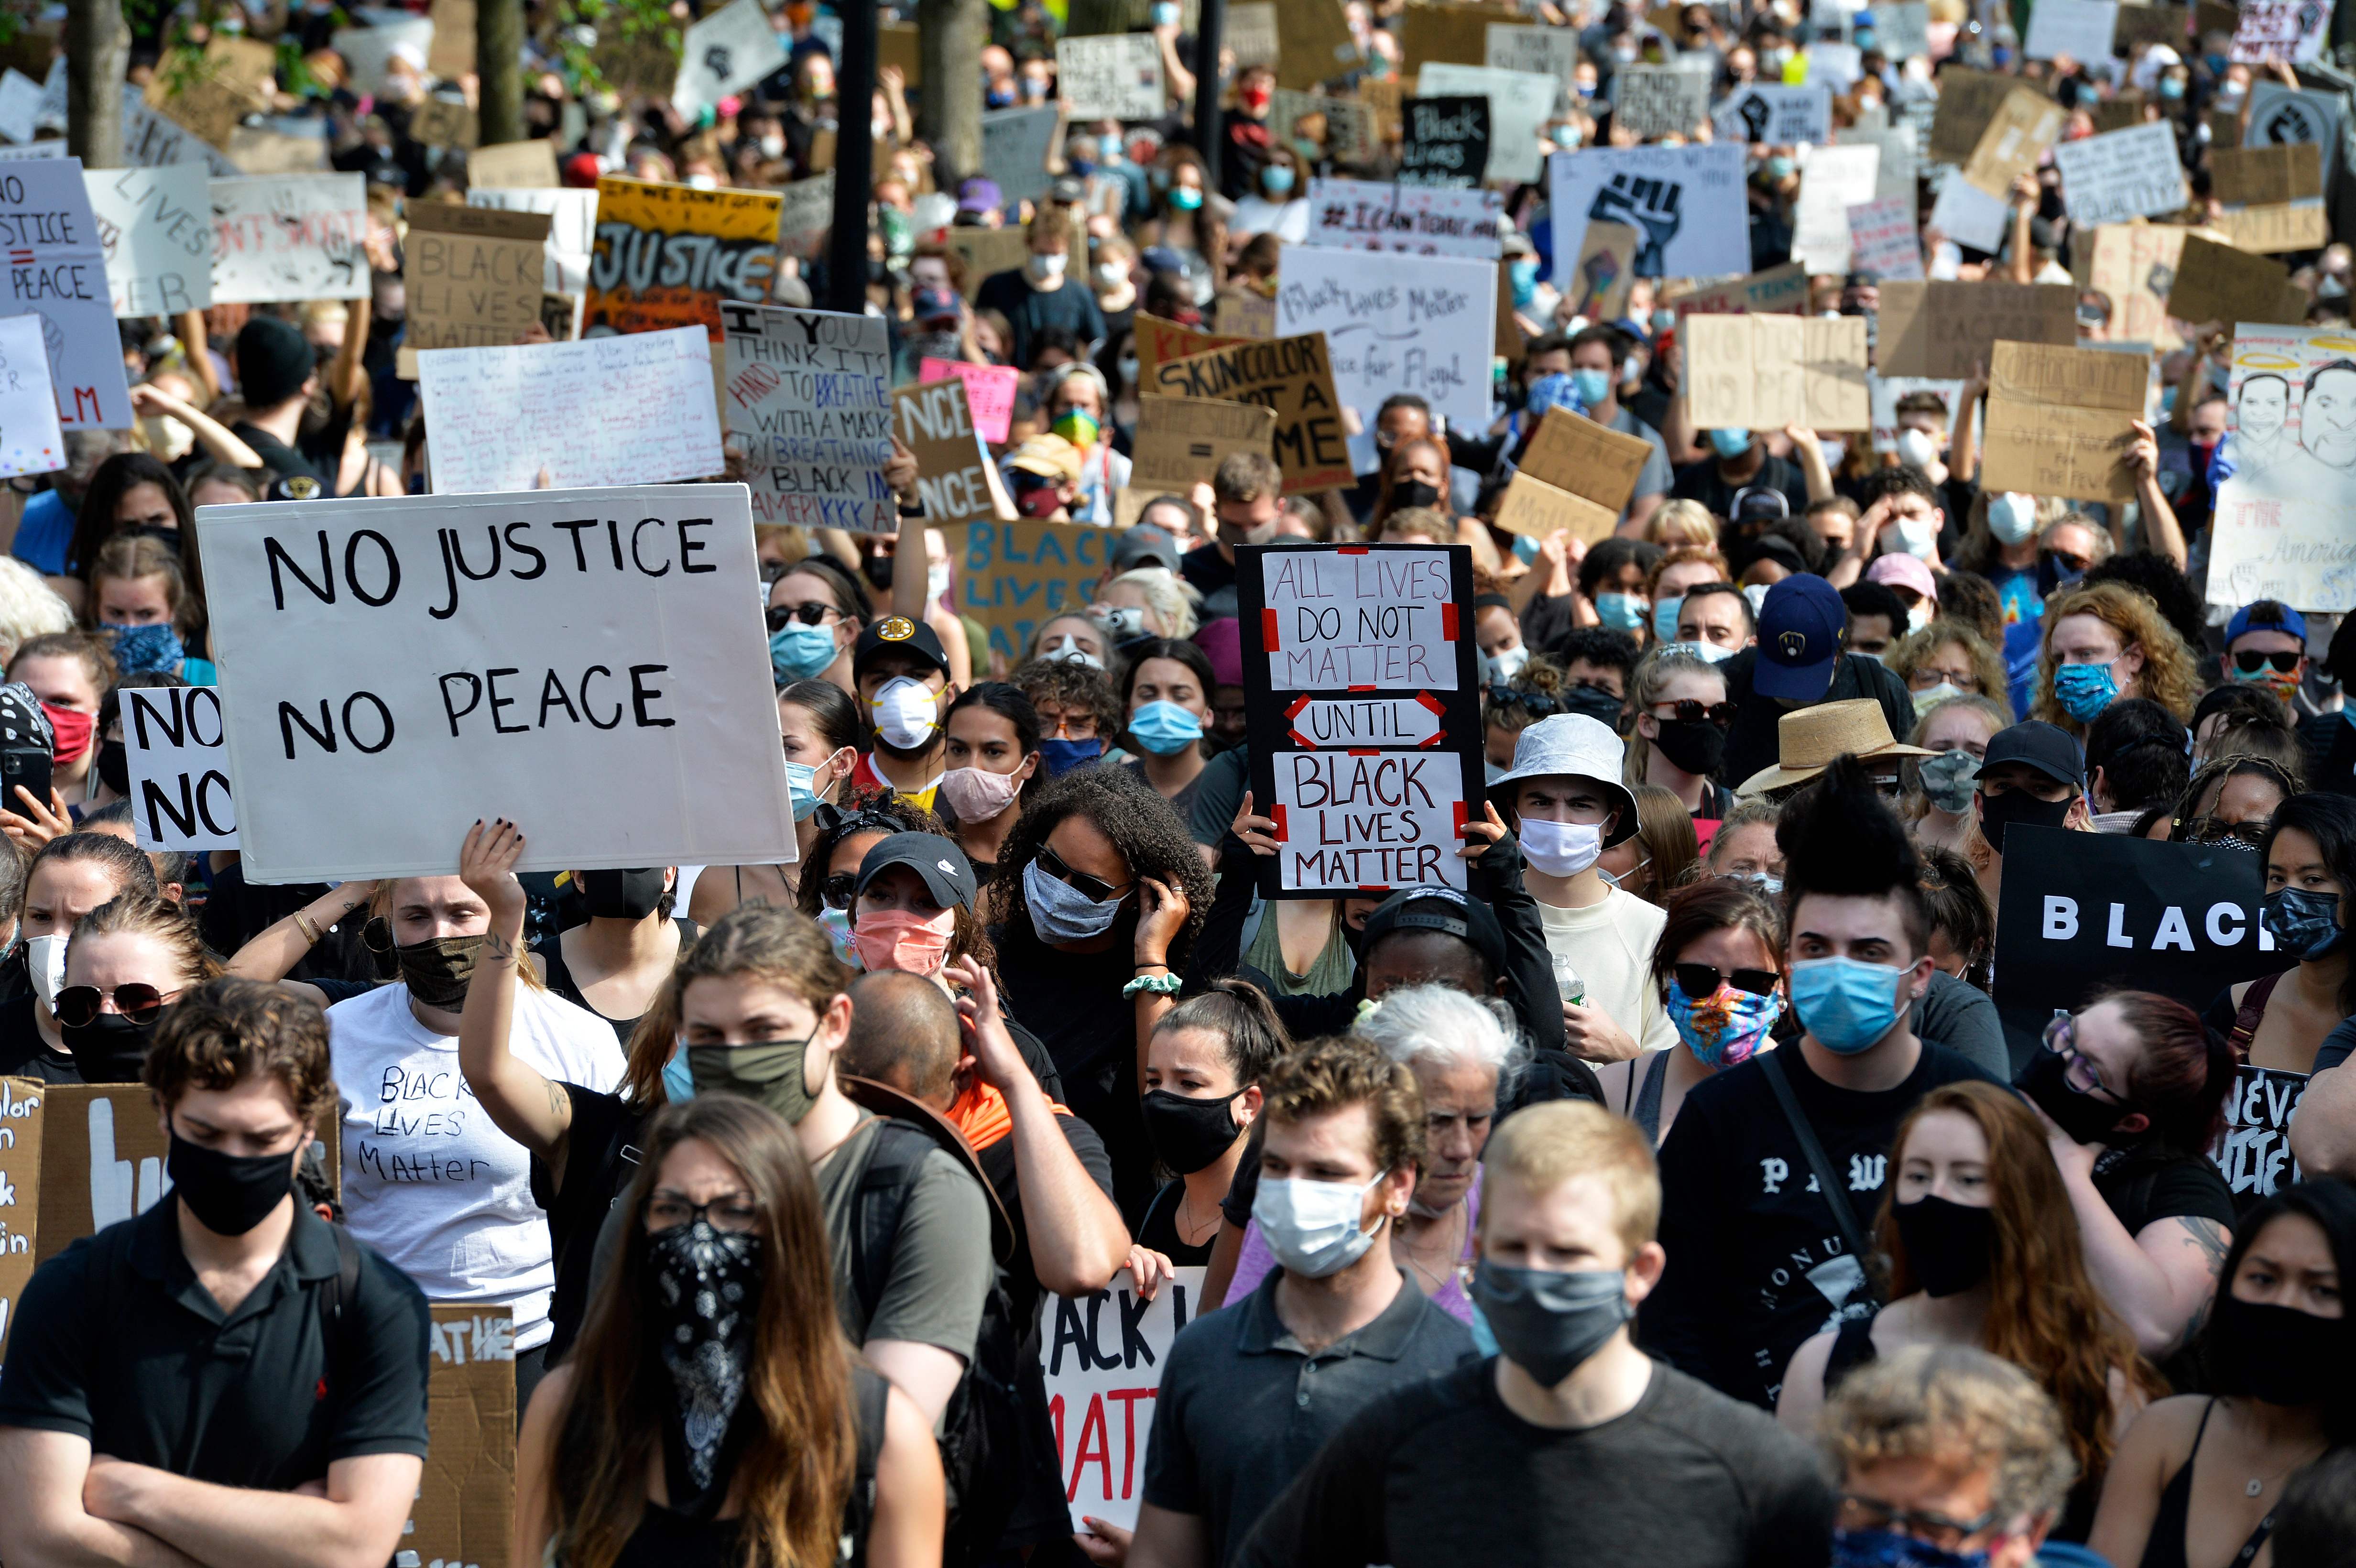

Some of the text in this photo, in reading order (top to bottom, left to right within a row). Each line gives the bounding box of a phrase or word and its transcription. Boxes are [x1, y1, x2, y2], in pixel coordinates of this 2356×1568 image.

[1414, 100, 1485, 142] Black
[0, 175, 23, 205] O
[112, 169, 211, 256] LIVES
[12, 265, 93, 300] PEACE
[419, 238, 536, 286] BLACK
[417, 285, 536, 324] LIVES
[723, 307, 783, 335] IF
[794, 315, 862, 348] YOU
[1696, 324, 1742, 366] NO
[736, 337, 824, 368] THINK
[728, 361, 890, 410] HARD TO BREATHE
[1301, 382, 1330, 411] A
[750, 407, 890, 439] WITH A MASK
[731, 430, 890, 468] TRY BREATHING
[771, 466, 858, 496] BLACK
[866, 470, 890, 500] IN
[2233, 500, 2281, 527] THE
[263, 517, 718, 620] NO JUSTICE
[1272, 557, 1449, 600] ALL LIVES
[965, 577, 1097, 610] LIVES
[1297, 605, 1425, 643] DO NOT
[1287, 644, 1436, 686] MATTER
[130, 687, 223, 751] NO
[279, 664, 676, 759] NO PEACE
[1311, 702, 1415, 741] UNTIL
[1293, 755, 1436, 809] BLACK
[141, 769, 237, 842] NO
[1320, 810, 1422, 846] LIVES
[1295, 844, 1451, 887] MATTER
[0, 1080, 40, 1121] lor
[381, 1066, 474, 1102] BLACK
[375, 1106, 465, 1136] LIVES
[1041, 1285, 1156, 1377] ACK
